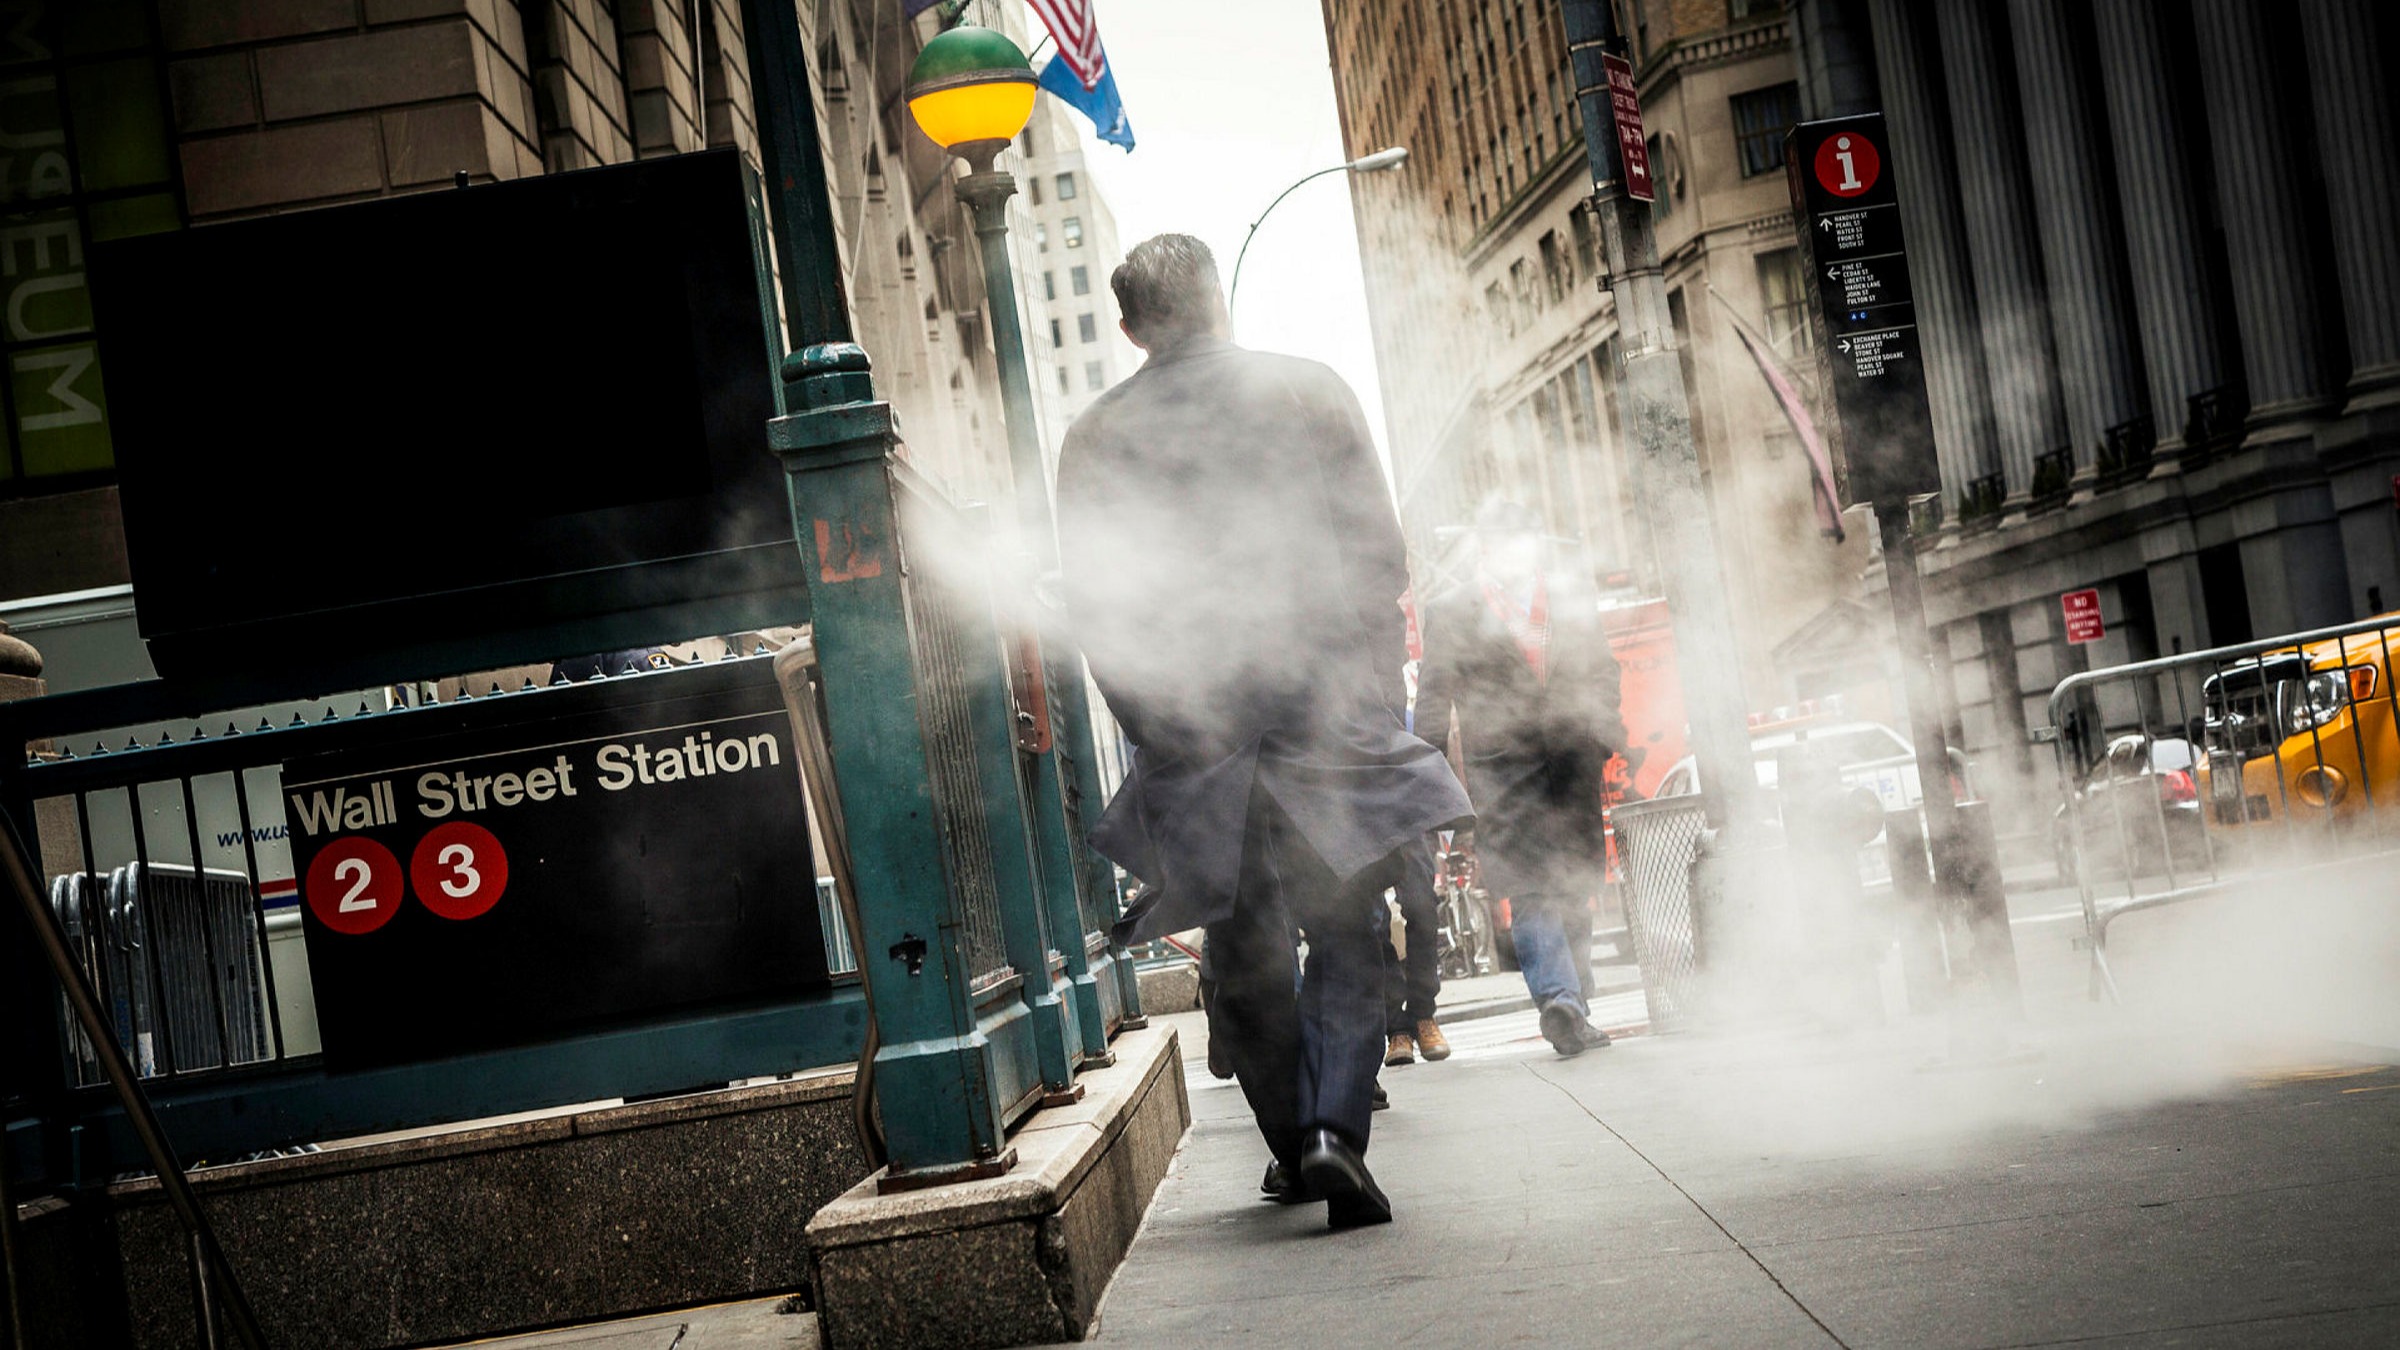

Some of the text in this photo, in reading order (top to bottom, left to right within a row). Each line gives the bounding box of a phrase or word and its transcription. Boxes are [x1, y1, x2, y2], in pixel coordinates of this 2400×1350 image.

[1834, 211, 1867, 222] HANOVER ST
[1835, 219, 1861, 229] PEARL ST
[1837, 226, 1863, 236] WATER ST
[1837, 234, 1855, 242] FRONT
[1838, 239, 1864, 250] SOUTH ST
[1841, 263, 1854, 271] PINE
[1842, 268, 1868, 278] CEDAR ST
[1844, 274, 1874, 285] LIBERTY ST
[1845, 280, 1881, 292] MAIDEN LANE
[1846, 289, 1869, 299] JOHN ST
[1847, 294, 1876, 305] FULTON ST
[1853, 331, 1900, 344] EXCHANGE PLACE
[1854, 340, 1883, 350] BEAVER ST
[1855, 347, 1881, 358] STONE ST
[1856, 351, 1904, 364] HANOVER SQUARE
[1857, 361, 1882, 371] PEARL ST
[1858, 367, 1884, 378] WATER ST
[2074, 596, 2087, 608] NO
[292, 731, 780, 836] Wall Street Station
[334, 843, 481, 914] 2 3
